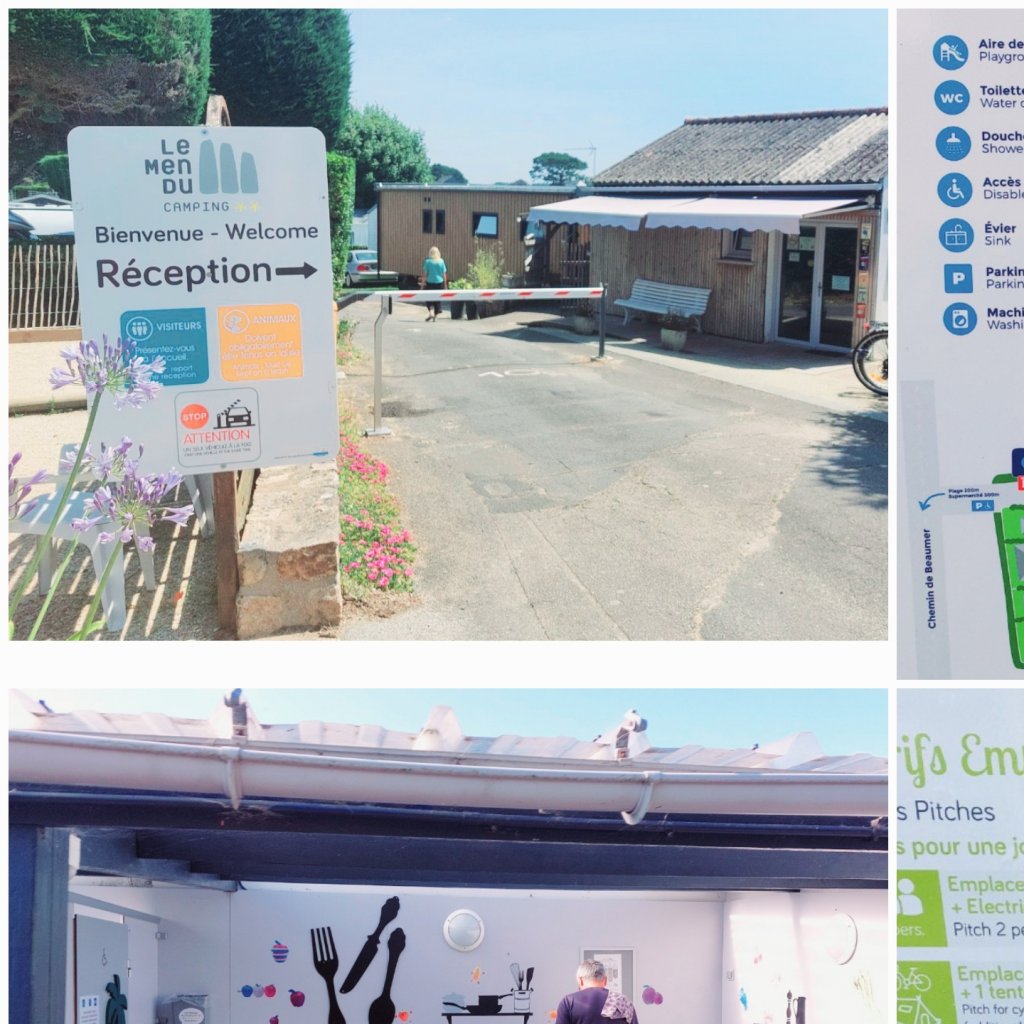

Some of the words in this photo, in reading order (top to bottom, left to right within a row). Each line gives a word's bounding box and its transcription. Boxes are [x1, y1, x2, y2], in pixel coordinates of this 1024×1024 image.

[979, 39, 1004, 48] Aire
[1009, 39, 1024, 49] de
[941, 94, 963, 103] WC
[980, 98, 1017, 108] Water
[983, 177, 1021, 187] Accès
[164, 202, 229, 212] CAMPING
[96, 226, 203, 243] Bienvenue
[225, 222, 318, 239] Welcome
[985, 221, 1016, 233] Évier
[985, 236, 1010, 245] Sink
[97, 257, 271, 292] Réception
[953, 272, 965, 284] P
[157, 321, 203, 330] VISITEURS
[183, 412, 207, 422] STOP
[183, 428, 250, 444] ATTENTION
[923, 528, 933, 573] Beaumer
[925, 576, 934, 588] de
[927, 590, 936, 629] Chemin
[915, 800, 995, 821] Pitches
[912, 841, 960, 860] pour
[968, 842, 1006, 855] une
[962, 1004, 990, 1014] Pitch
[993, 1004, 1008, 1014] for
